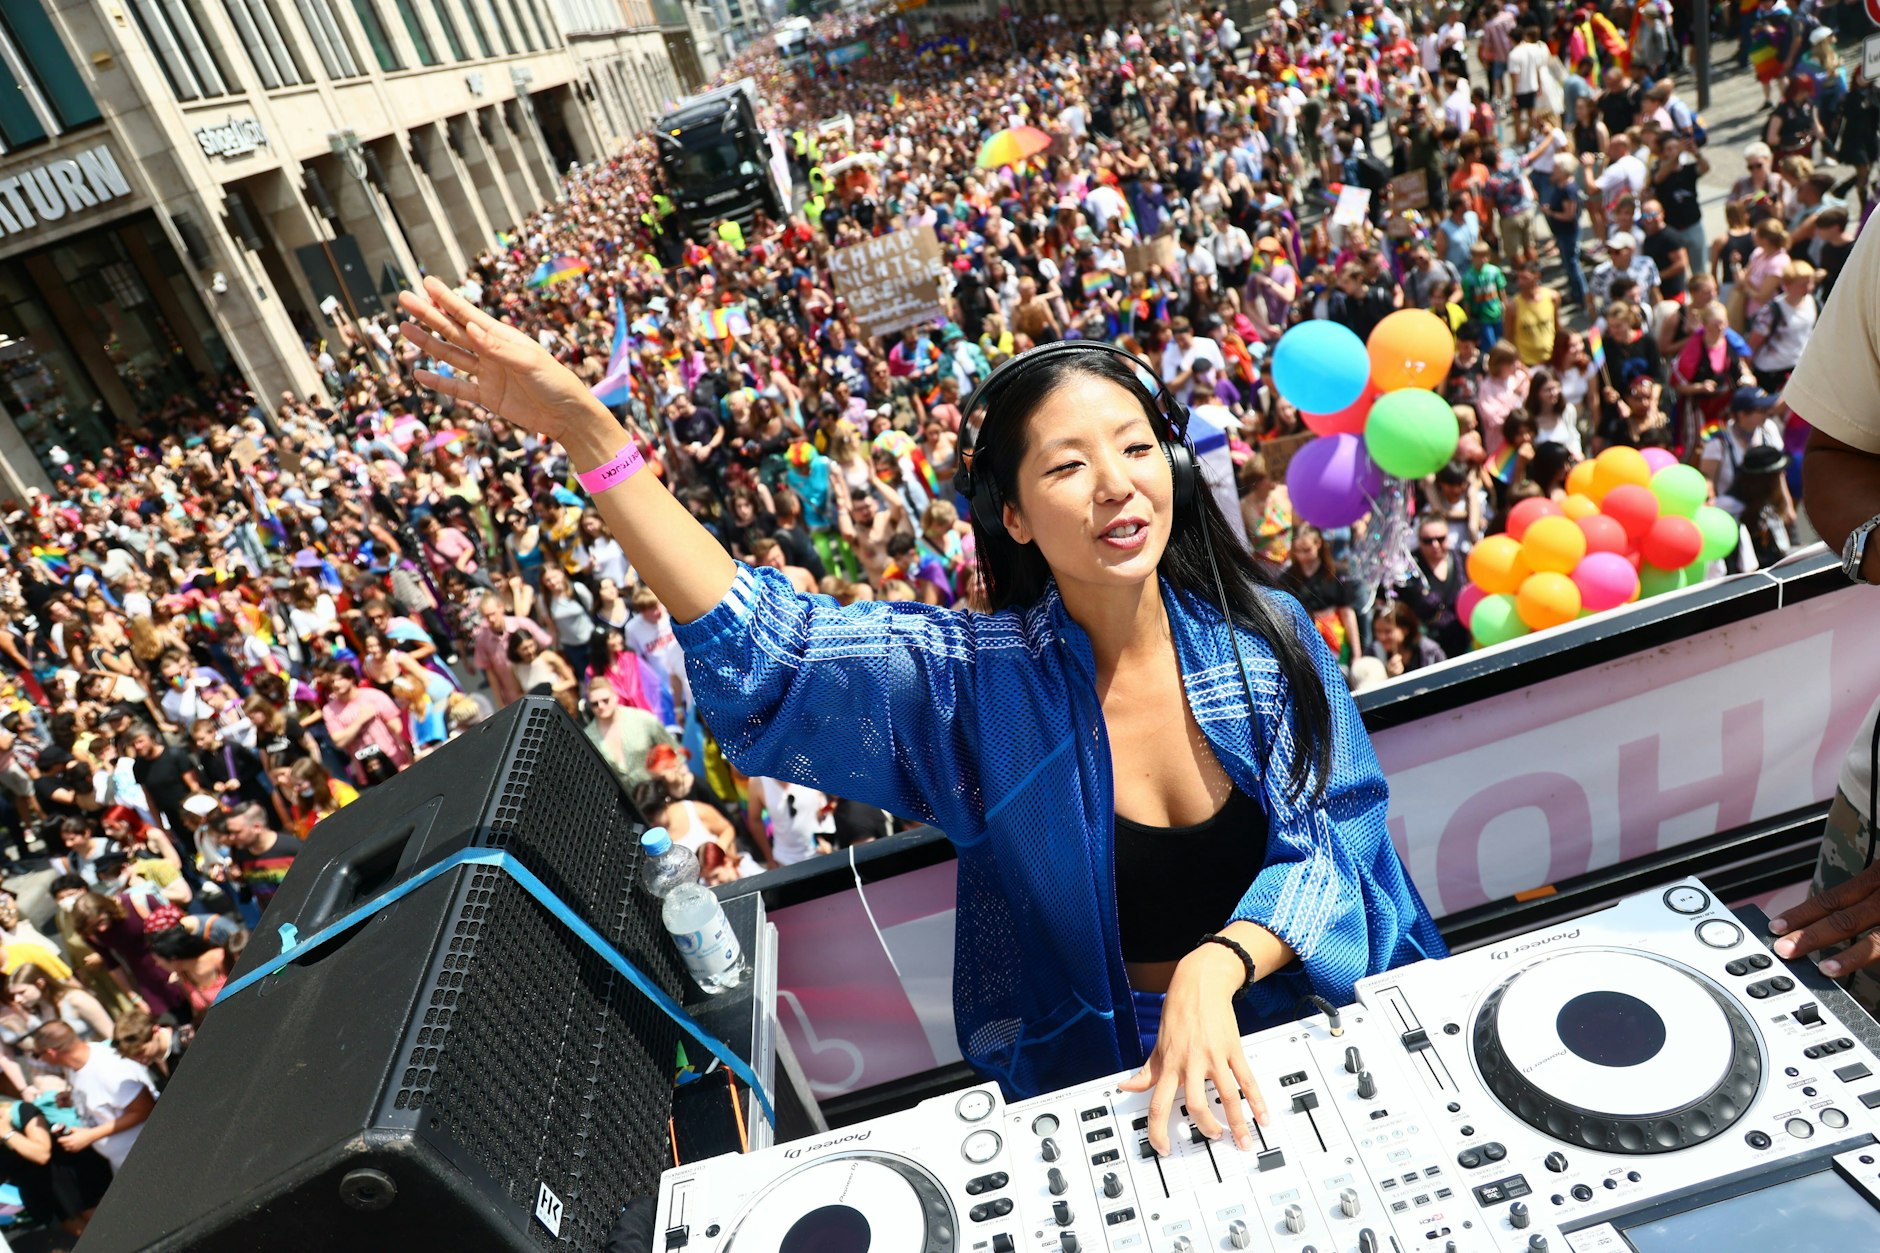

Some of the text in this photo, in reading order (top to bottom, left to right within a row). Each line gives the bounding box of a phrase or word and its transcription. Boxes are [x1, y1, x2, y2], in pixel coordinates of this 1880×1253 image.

[837, 248, 921, 293] NICHTS
[1513, 928, 1581, 954] Pioneer
[1534, 1049, 1567, 1069] Pioneer
[805, 1130, 872, 1153] Pioneer
[837, 1172, 855, 1203] Pioneer
[1481, 1186, 1498, 1195] MODE
[1486, 1190, 1499, 1201] JOG
[540, 1188, 561, 1222] HK
[1120, 1237, 1132, 1245] CUE
